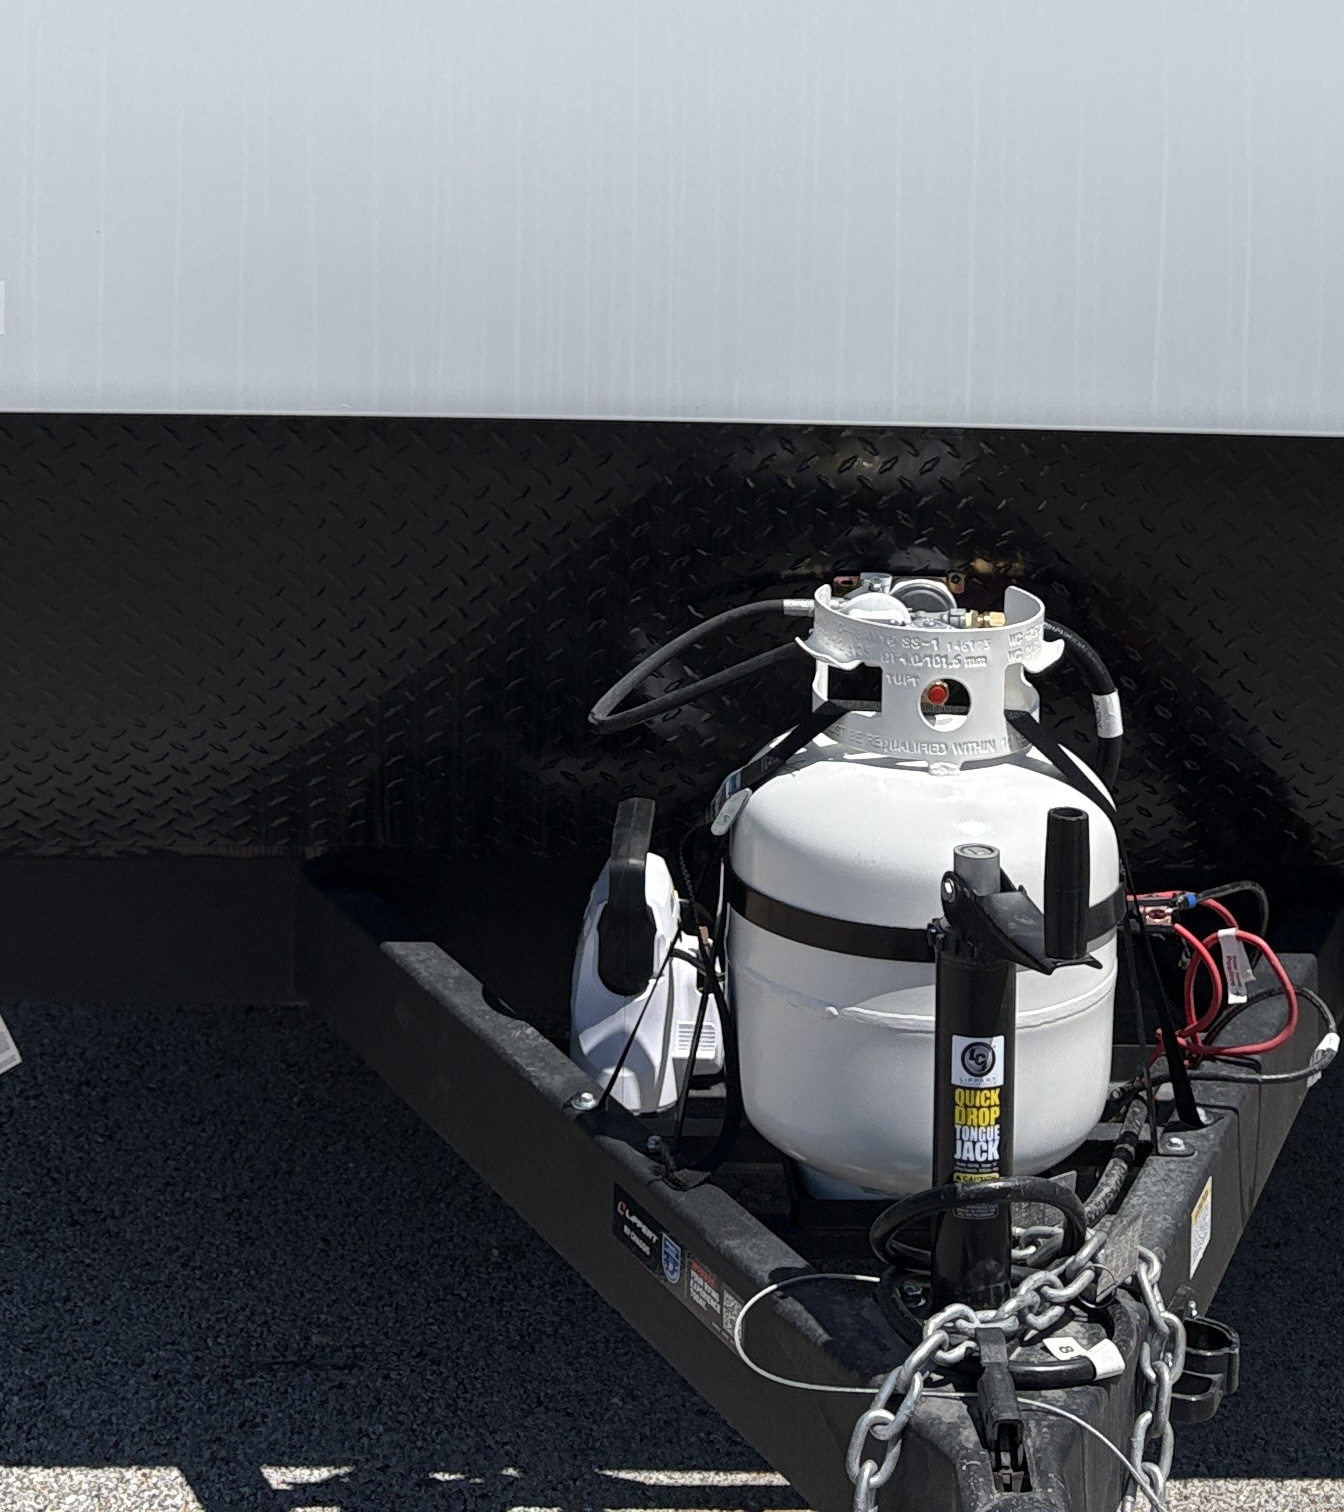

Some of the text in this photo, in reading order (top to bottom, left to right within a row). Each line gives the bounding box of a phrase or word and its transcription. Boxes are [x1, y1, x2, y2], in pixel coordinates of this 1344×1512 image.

[954, 1088, 1001, 1107] QUICK
[954, 1106, 1001, 1127] DROP
[954, 1124, 1001, 1142] TONGUE
[954, 1140, 1000, 1162] JACK
